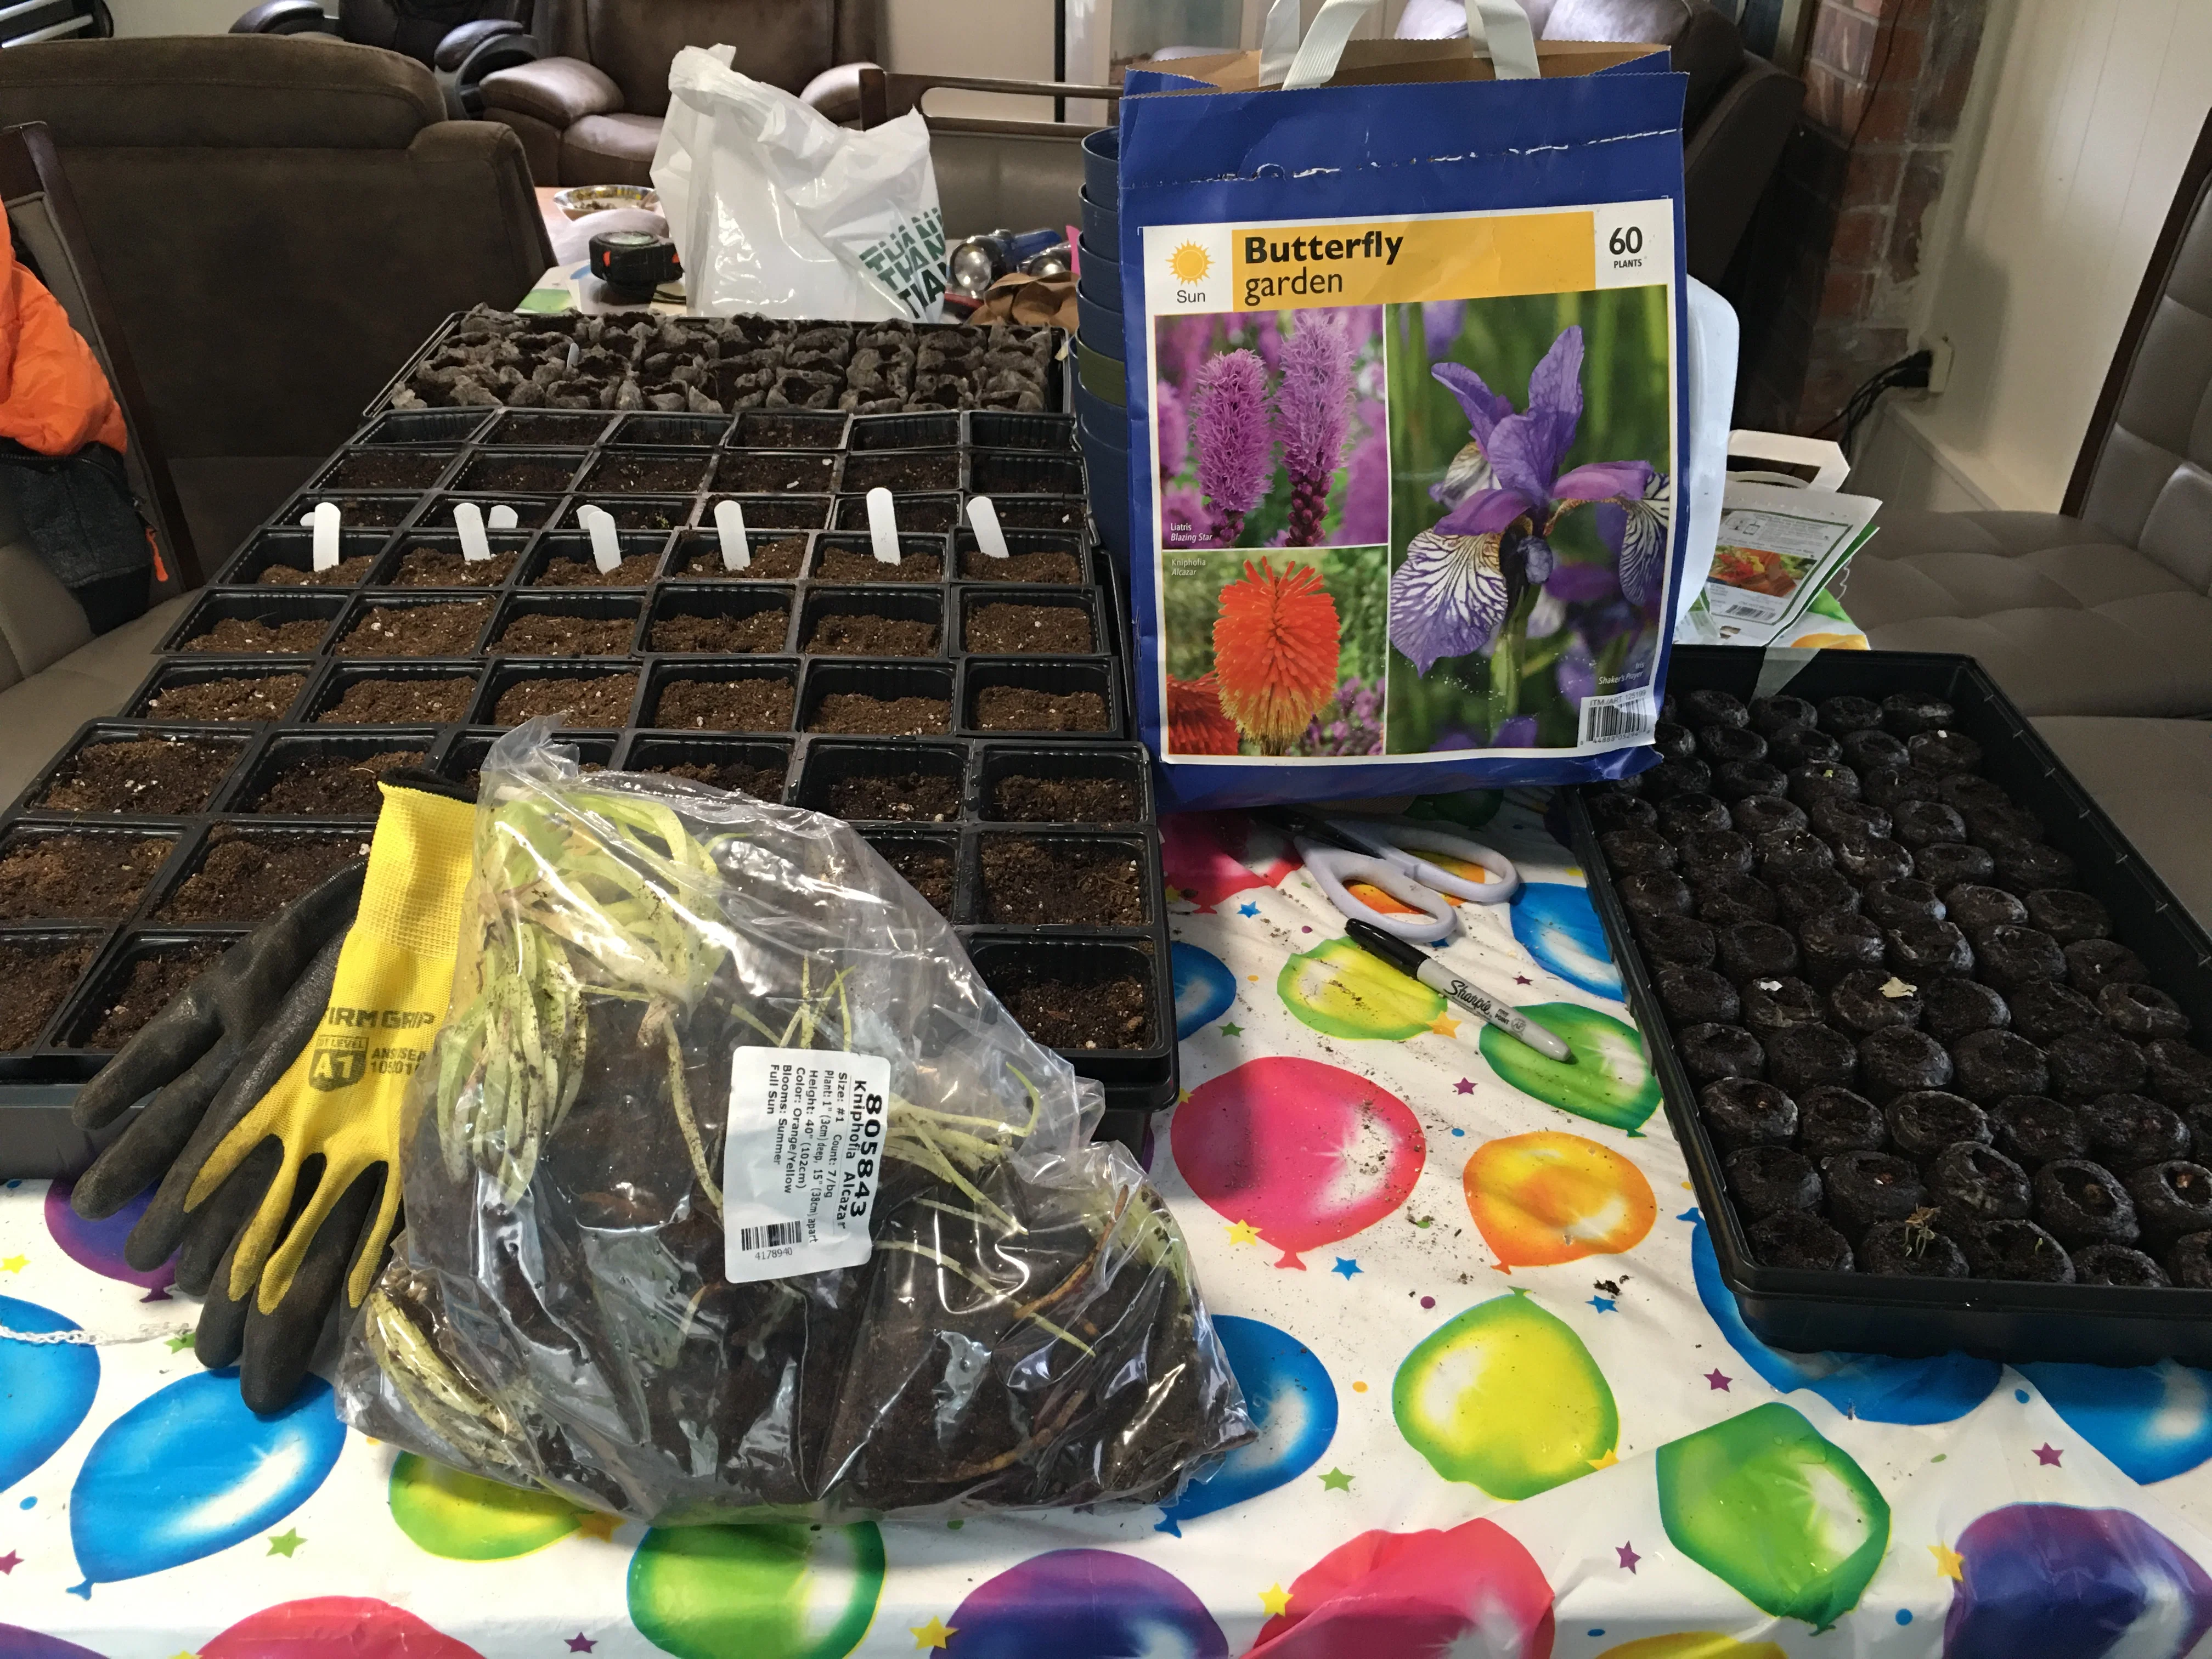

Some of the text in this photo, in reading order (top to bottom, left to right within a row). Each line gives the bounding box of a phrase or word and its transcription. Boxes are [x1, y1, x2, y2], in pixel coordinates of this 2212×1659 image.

[1245, 230, 1403, 265] Butterfly
[1609, 226, 1643, 255] 60
[1613, 258, 1643, 269] PLANTS
[1176, 290, 1206, 303] Sun
[1244, 266, 1342, 306] garden
[1170, 523, 1192, 531] Liatris
[1171, 532, 1213, 543] Blazing Star
[1171, 558, 1206, 567] Kniphofia
[1598, 672, 1644, 684] Shaker's Prayer
[1626, 690, 1646, 700] 125199
[1443, 979, 1492, 1015] Sharpie
[324, 1007, 379, 1028] IRM
[1494, 1013, 1510, 1025] POINT
[313, 1052, 354, 1079] A1
[767, 1064, 780, 1114] Full Sun
[823, 1070, 834, 1097] Plant:
[774, 1064, 792, 1165] Blooms: Summer
[785, 1067, 806, 1193] Color: Orange/Yellow
[795, 1070, 819, 1189] Height: 40" (102cm)
[823, 1073, 848, 1198] Size: #1 Count: 7/bg
[837, 1080, 867, 1229] Kniphofia Alcazar
[850, 1093, 882, 1217] 805843
[806, 1218, 819, 1243] apart
[754, 1246, 793, 1260] 4178940
